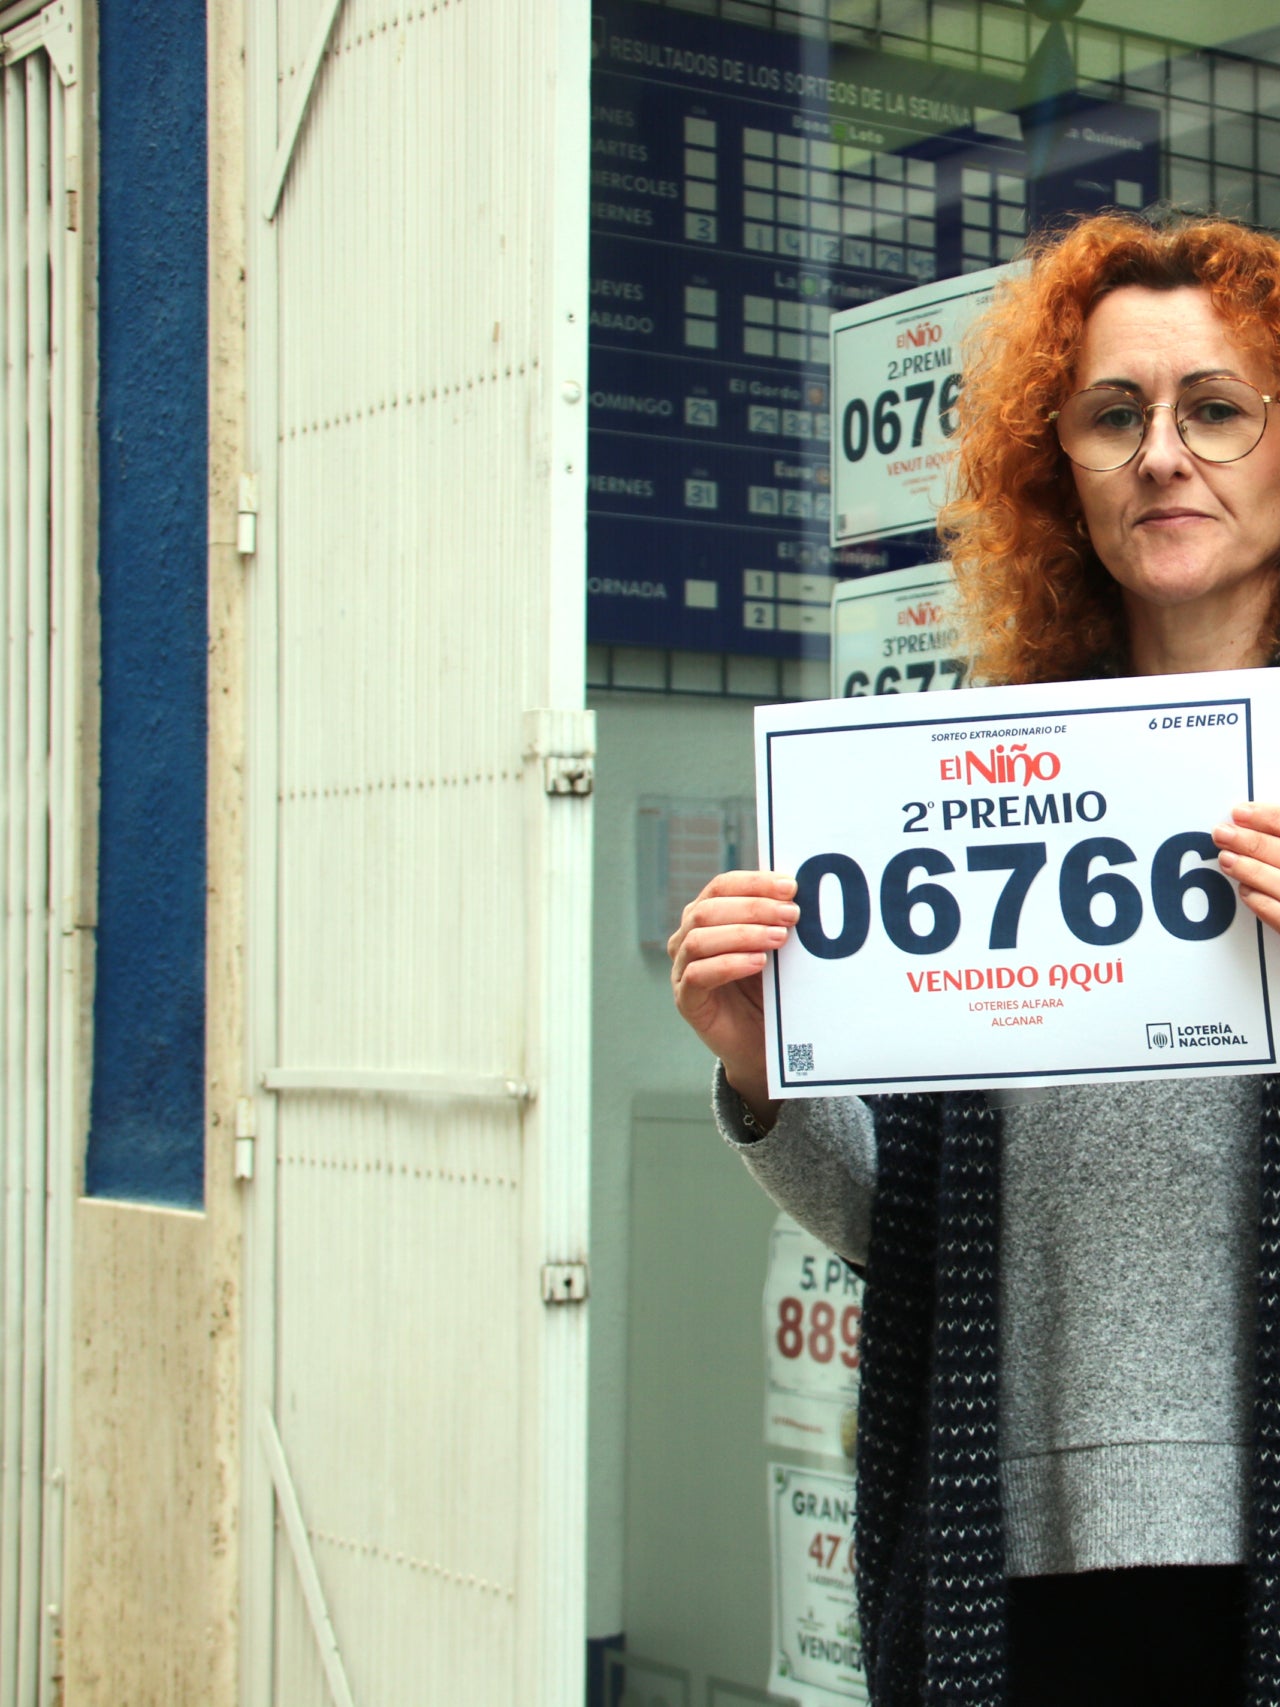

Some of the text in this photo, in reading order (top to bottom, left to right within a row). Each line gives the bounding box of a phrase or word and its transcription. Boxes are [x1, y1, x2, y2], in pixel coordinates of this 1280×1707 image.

[609, 34, 971, 126] RESULTADOS DE LOS SORTEOS DE LA SEMANA
[774, 270, 797, 290] La
[748, 381, 801, 400] Gordo
[1148, 712, 1239, 730] 6 DE ENERO
[930, 724, 1068, 742] SORTEO EXTRAORDINARIO DE
[964, 743, 1062, 787] Niño
[901, 790, 1108, 833] 2º PREMIO
[796, 830, 1238, 960] 06766
[906, 958, 1124, 993] VENDIDO AQUÍ
[968, 998, 1065, 1012] LOTERIES ALFARA
[991, 1015, 1044, 1027] ALCANAR
[1177, 1022, 1233, 1036] LOTERÍA
[1178, 1035, 1249, 1048] NACIONAL
[776, 1296, 863, 1369] 889
